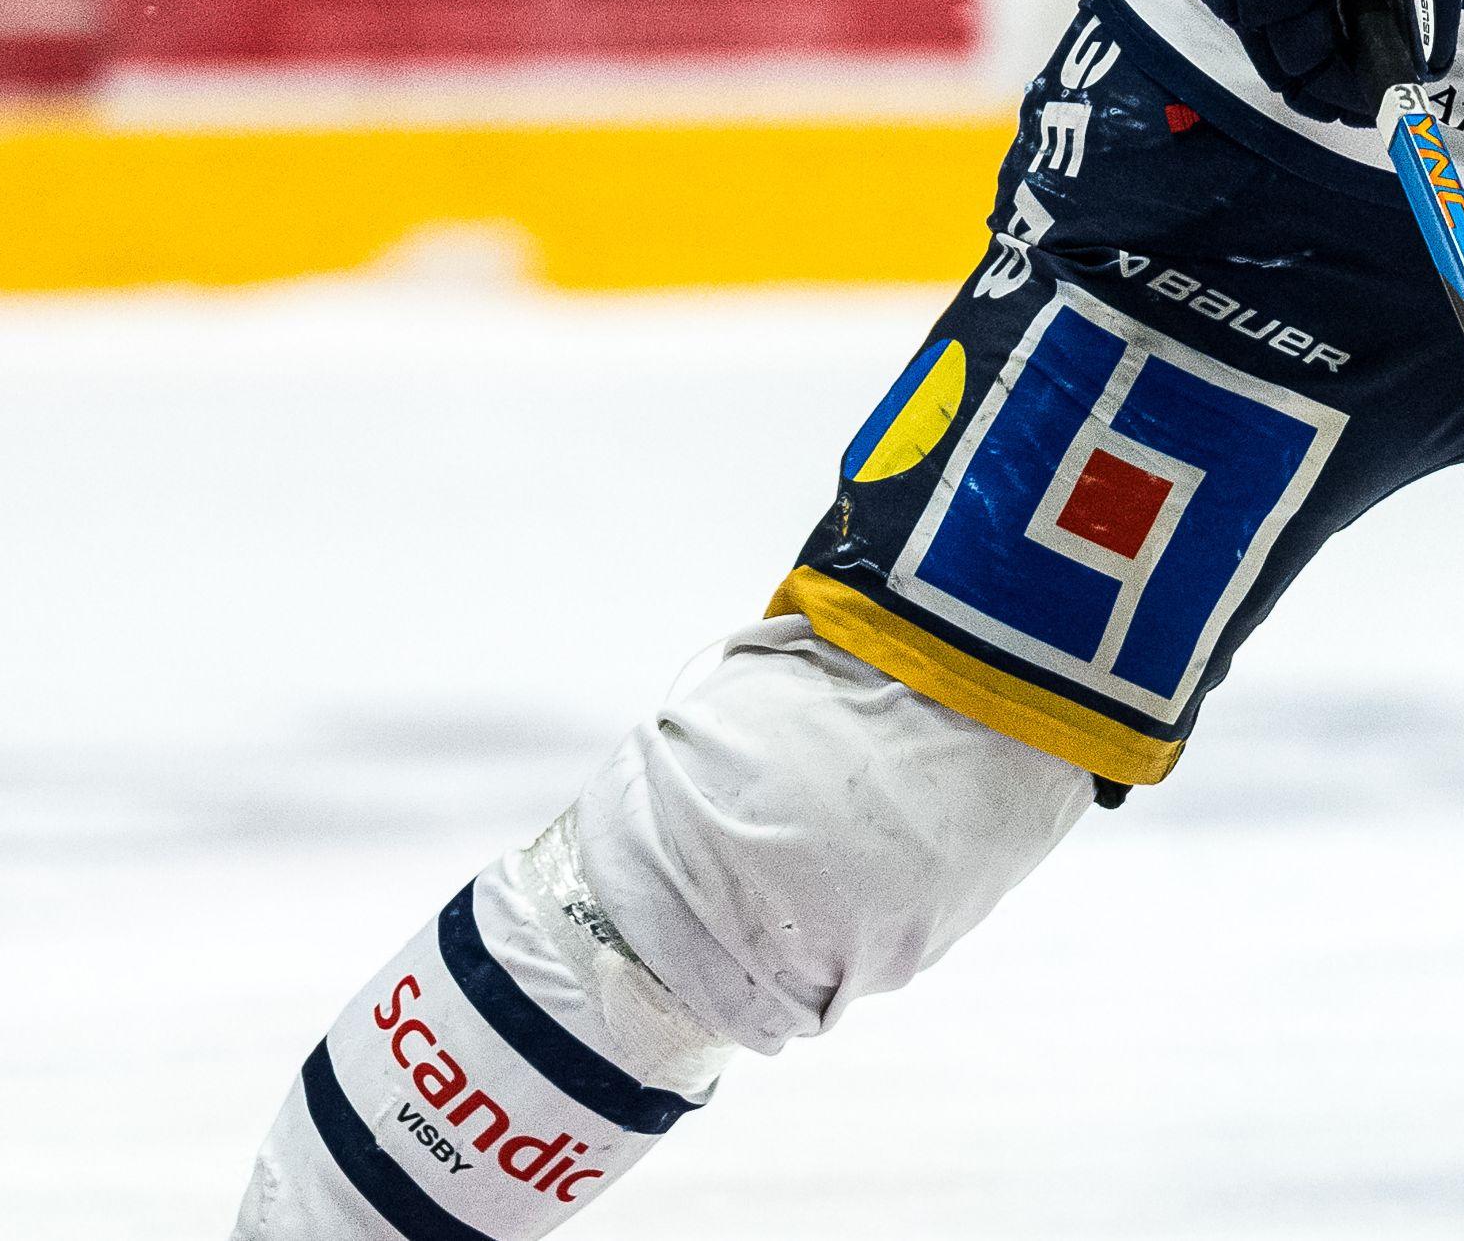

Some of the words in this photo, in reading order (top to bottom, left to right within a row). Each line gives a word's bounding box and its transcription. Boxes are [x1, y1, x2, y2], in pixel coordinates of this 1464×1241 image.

[1145, 267, 1352, 374] BAUER
[373, 973, 605, 1204] Scandic
[396, 1101, 475, 1175] VISBY
